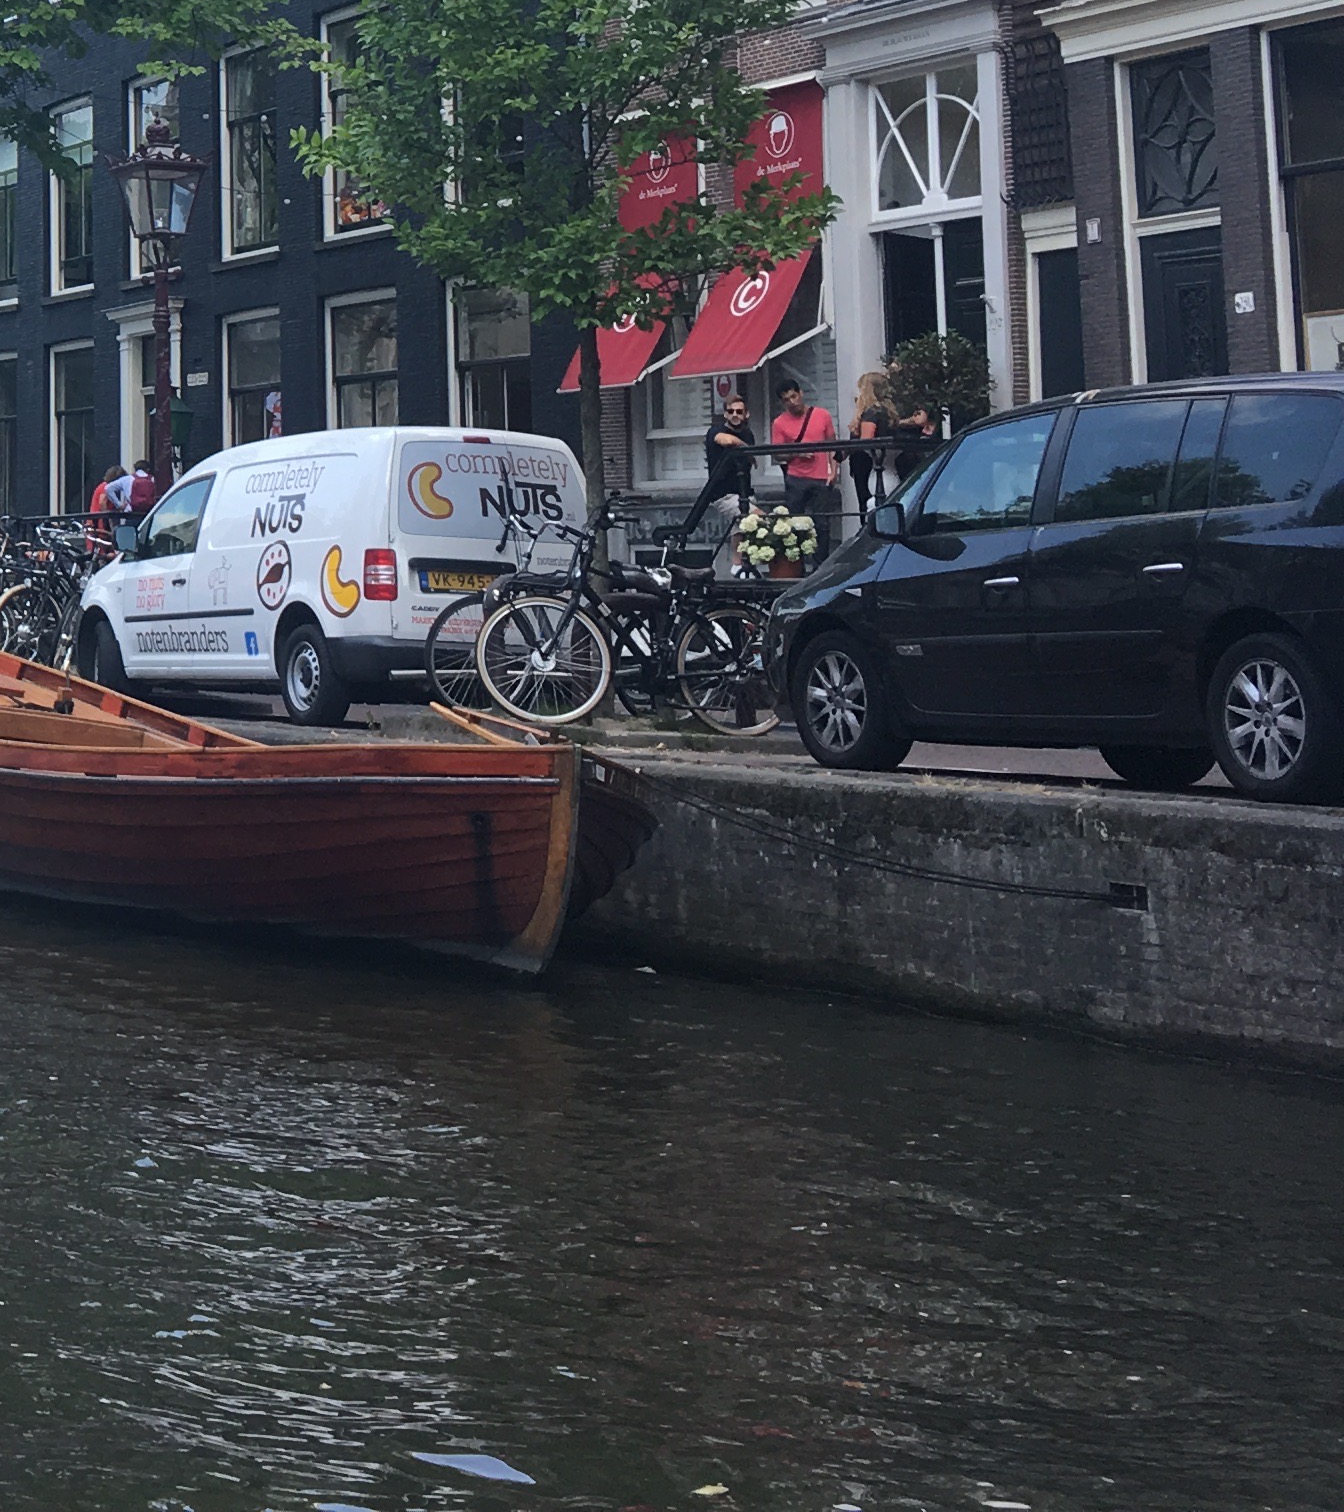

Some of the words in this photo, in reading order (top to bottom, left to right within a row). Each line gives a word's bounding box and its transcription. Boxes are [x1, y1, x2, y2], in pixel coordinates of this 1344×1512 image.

[245, 461, 326, 498] completely
[445, 451, 568, 488] completely
[250, 492, 306, 538] NUTS
[138, 579, 148, 592] no
[149, 577, 165, 590] nuts
[432, 572, 497, 589] VK-945-
[136, 595, 146, 609] no
[146, 594, 165, 611] glory
[136, 624, 229, 653] notenbranders
